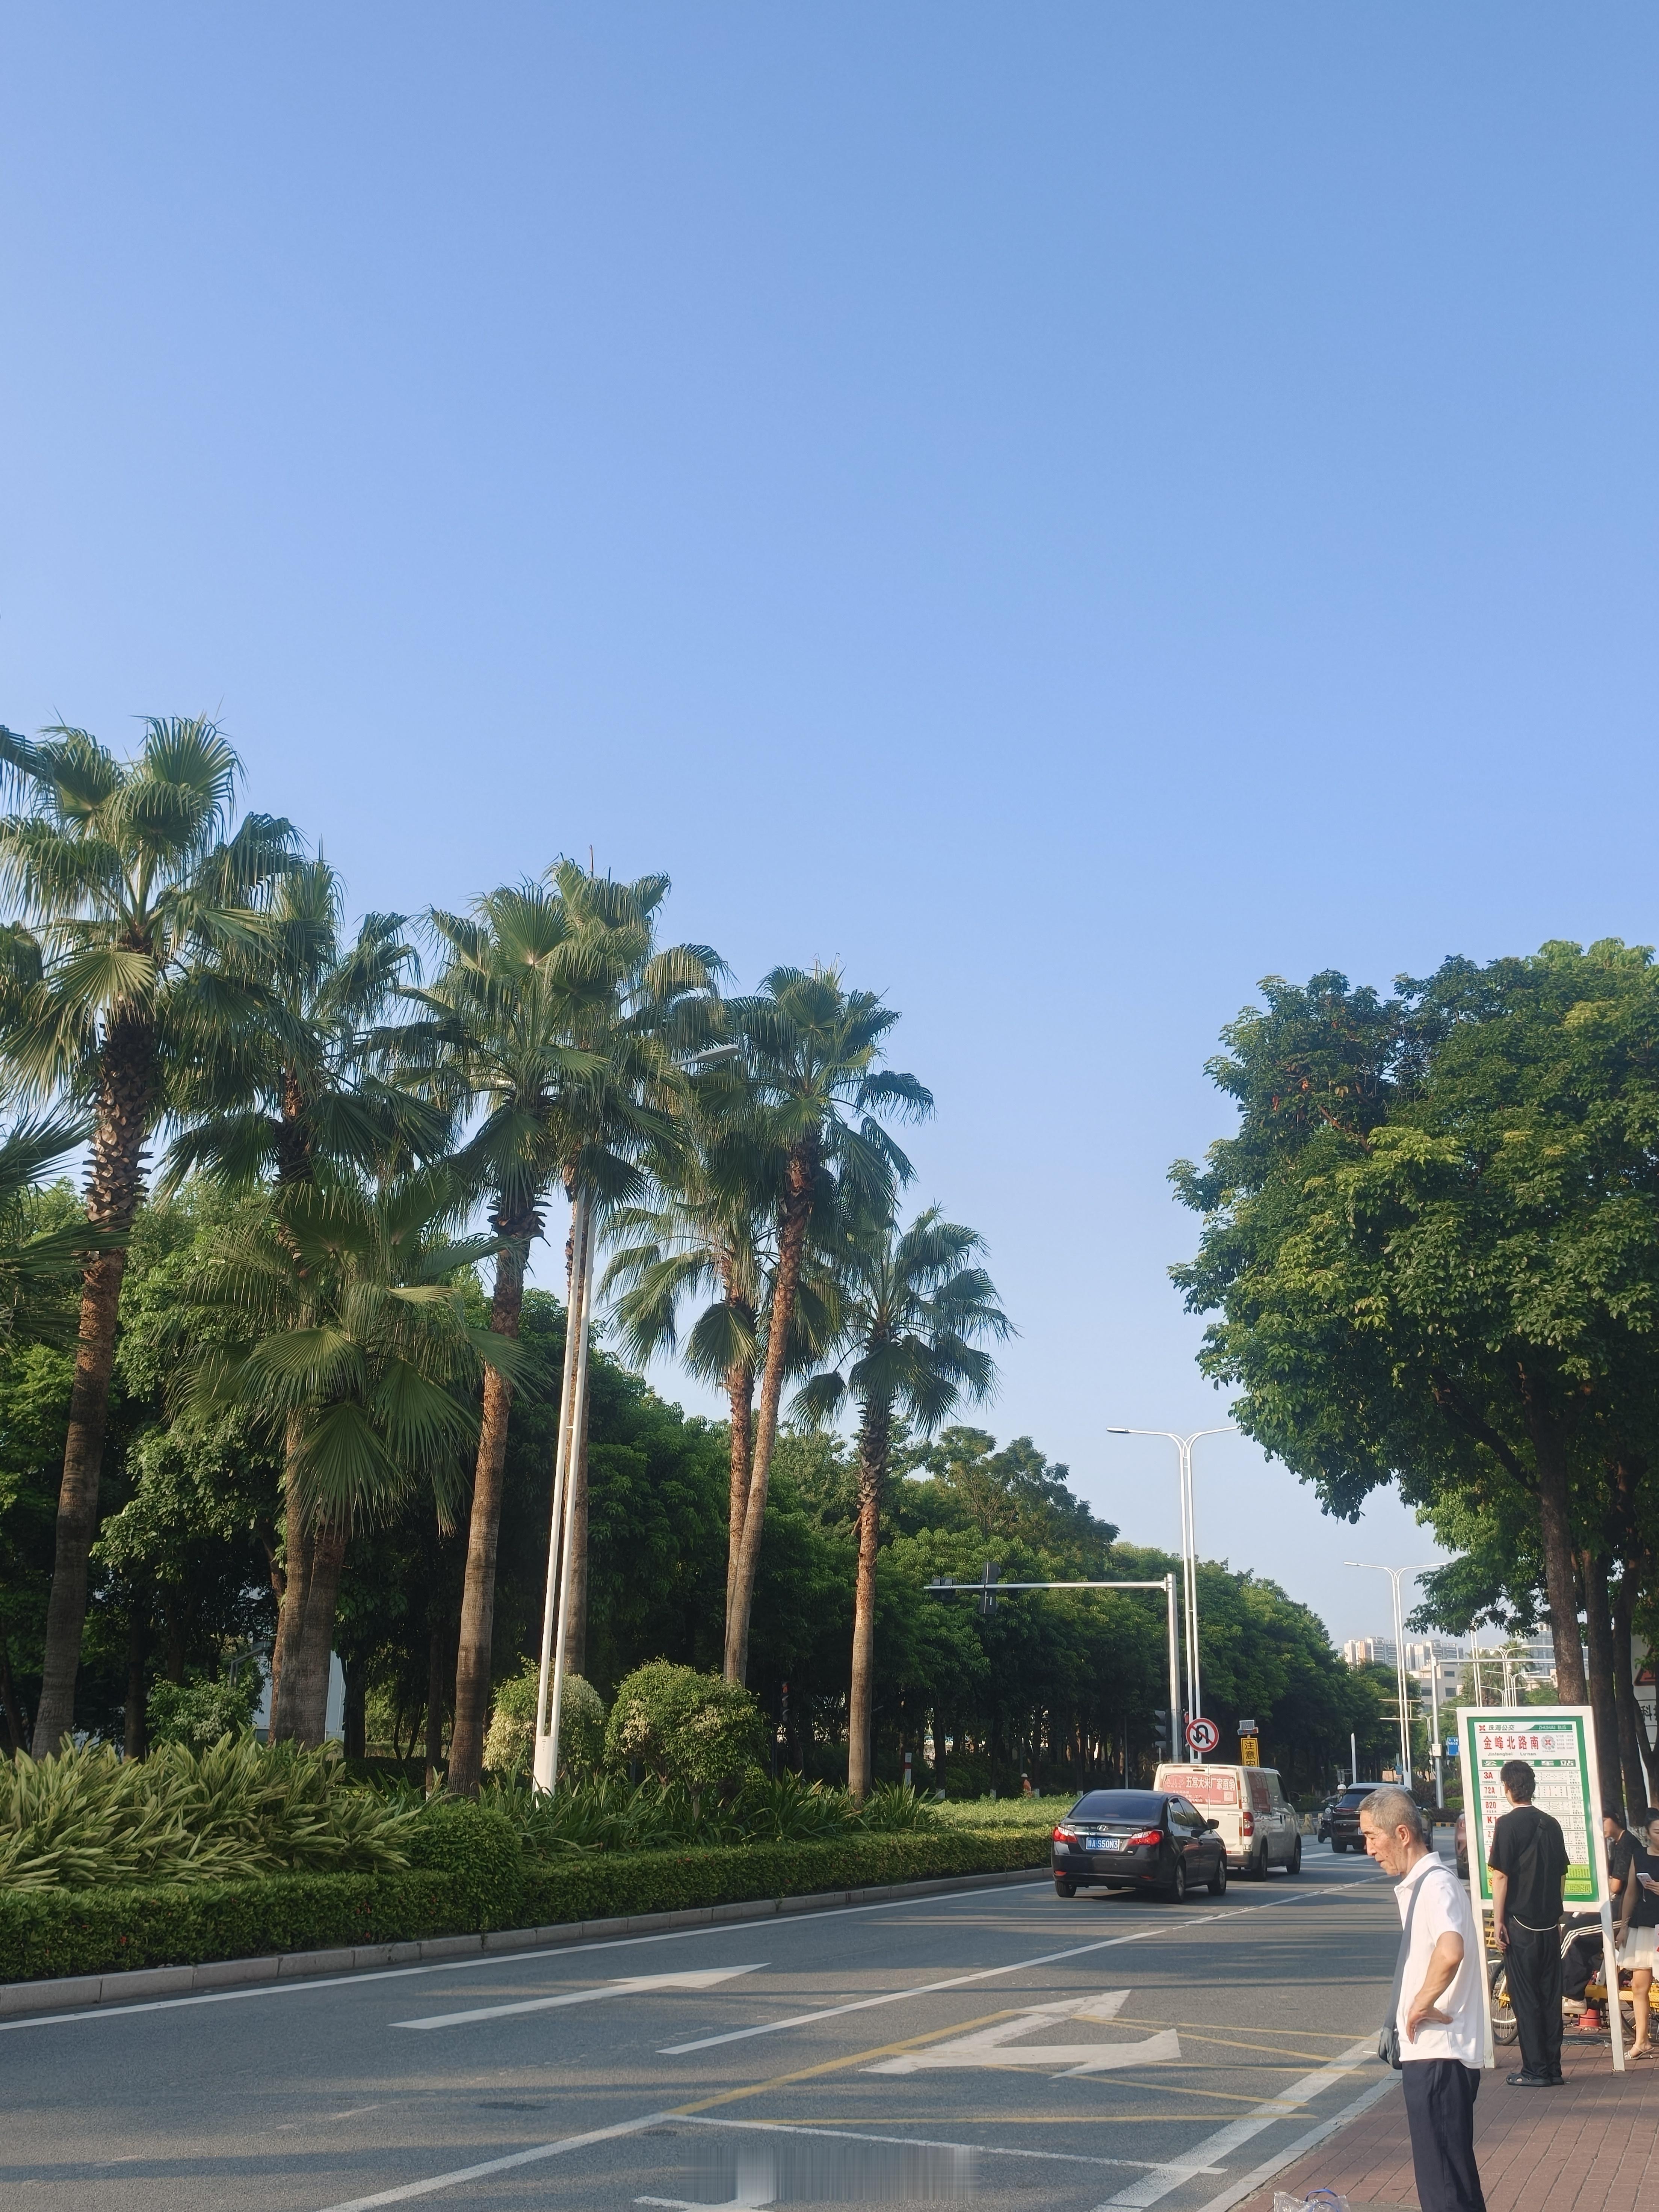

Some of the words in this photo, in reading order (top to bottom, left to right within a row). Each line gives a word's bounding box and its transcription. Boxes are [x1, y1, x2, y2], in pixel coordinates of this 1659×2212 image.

[1484, 1735, 1539, 1750] 金峰北路南
